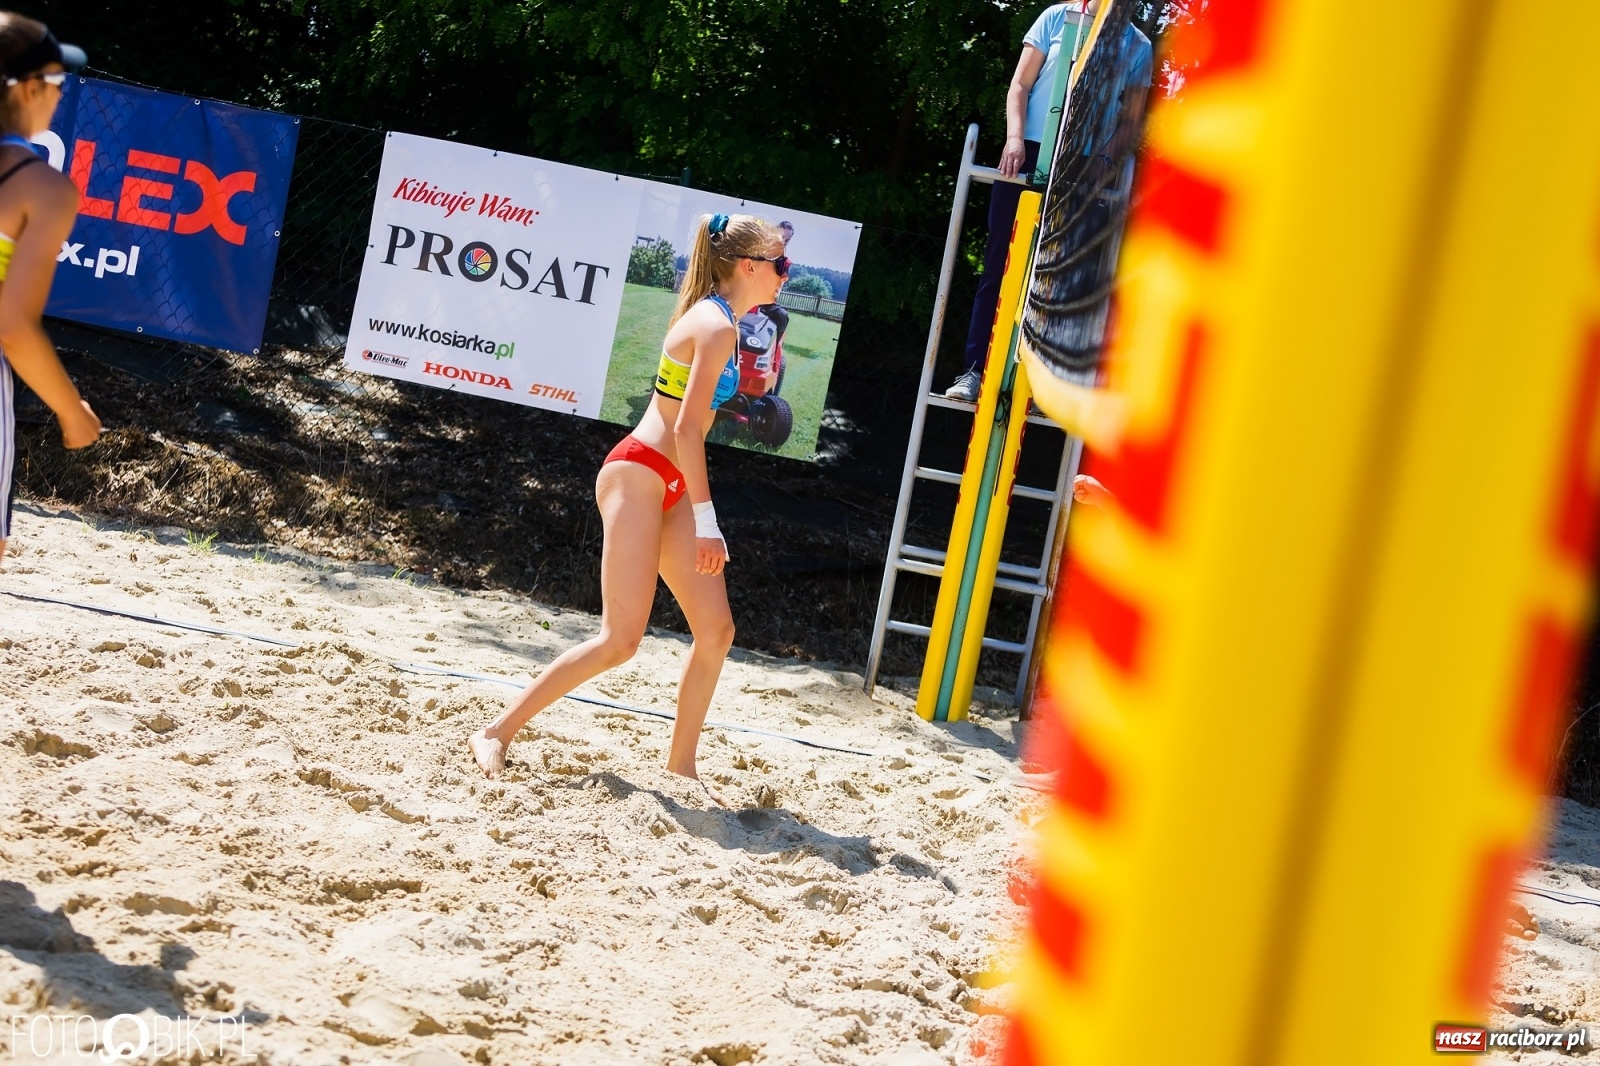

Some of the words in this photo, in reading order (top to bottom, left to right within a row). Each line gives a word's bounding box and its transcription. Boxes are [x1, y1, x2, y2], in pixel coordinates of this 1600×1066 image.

[392, 177, 476, 218] Kibicuje
[478, 193, 541, 227] Wam:
[380, 223, 610, 306] PROSAT
[368, 318, 515, 361] www.kosiarka.pl
[422, 361, 514, 391] HONDA
[528, 383, 578, 403] STIHL
